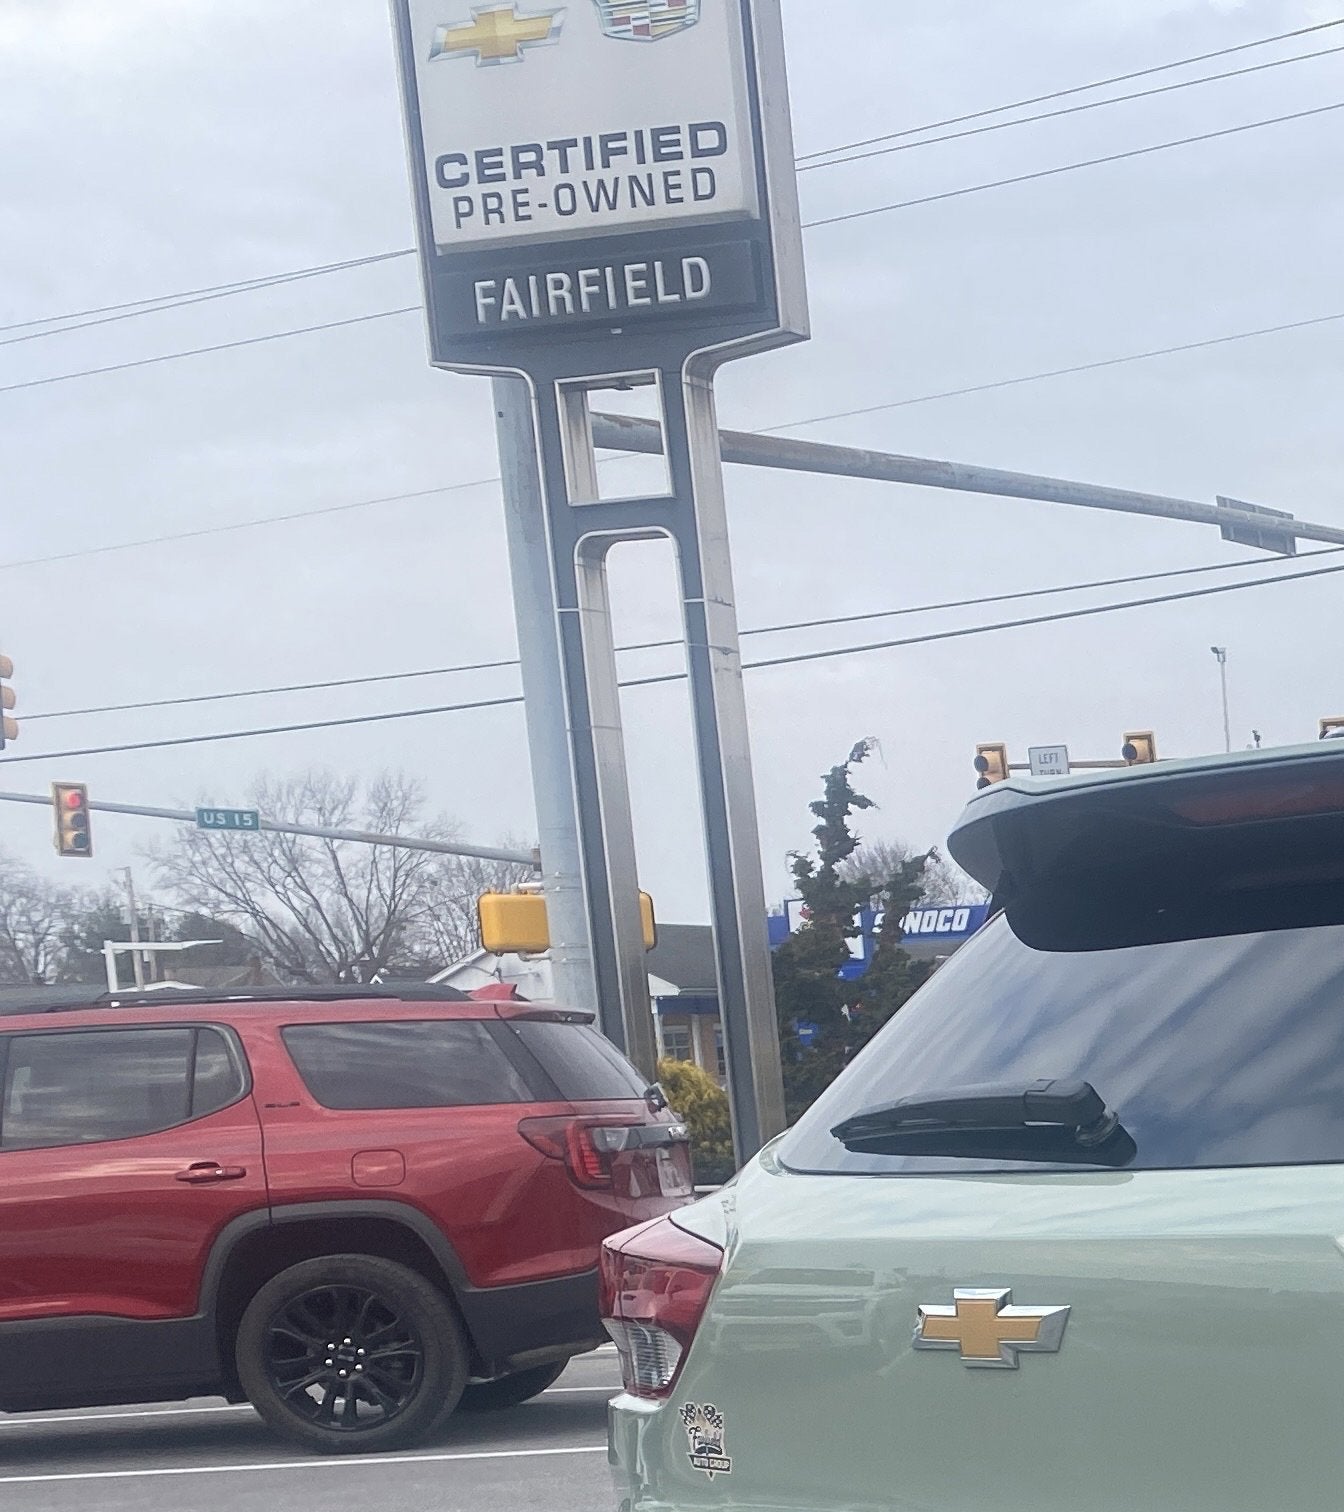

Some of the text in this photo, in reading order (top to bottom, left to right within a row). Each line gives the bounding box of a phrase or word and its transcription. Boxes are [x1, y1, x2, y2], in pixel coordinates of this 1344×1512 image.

[434, 120, 728, 189] CERTIFIED
[452, 166, 717, 229] PRE-OWNED
[474, 256, 712, 324] FAIRFIELD
[1038, 752, 1058, 764] LEFT
[203, 812, 253, 826] US 15
[872, 908, 970, 934] SNOCO
